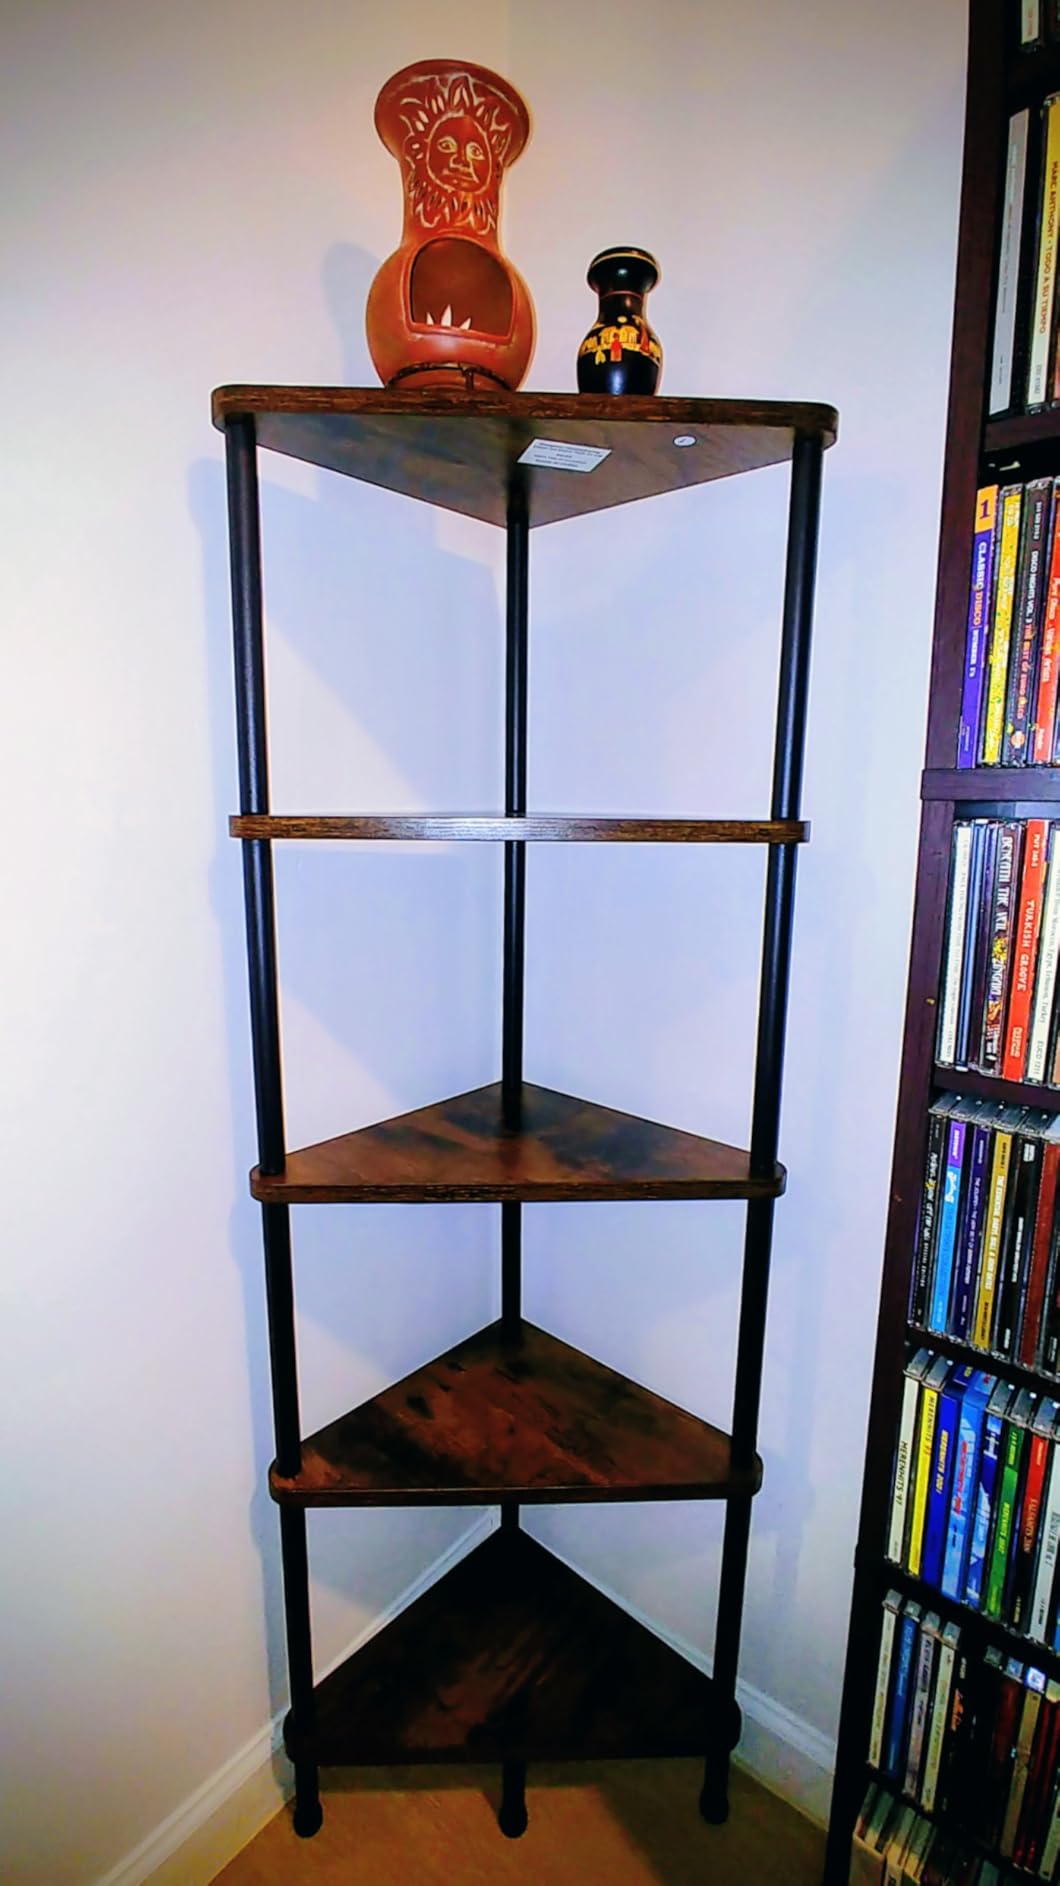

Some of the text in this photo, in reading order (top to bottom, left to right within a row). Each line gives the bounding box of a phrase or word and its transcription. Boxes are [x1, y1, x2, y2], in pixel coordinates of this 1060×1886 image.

[1050, 160, 1058, 188] MARC
[1047, 191, 1056, 238] ANTHONY
[1045, 246, 1054, 274] TODO
[1042, 286, 1050, 298] SU
[1043, 276, 1050, 284] A
[1039, 300, 1049, 334] TIEMPO
[980, 500, 990, 519] 1
[975, 542, 987, 590] CLASSIC
[1030, 550, 1039, 573] DISCO
[1027, 574, 1037, 600] NIGHTS
[973, 591, 984, 626] DISCO
[1026, 600, 1034, 617] VOL.
[1024, 624, 1033, 640] THE
[970, 630, 980, 665] NUMBER
[1019, 674, 1028, 696] EURO
[998, 836, 1013, 882] BENEATH
[1017, 900, 1035, 992] TURKISH GROOVE
[924, 1396, 936, 1442] MERENHITS
[896, 1441, 908, 1491] MERENHITS
